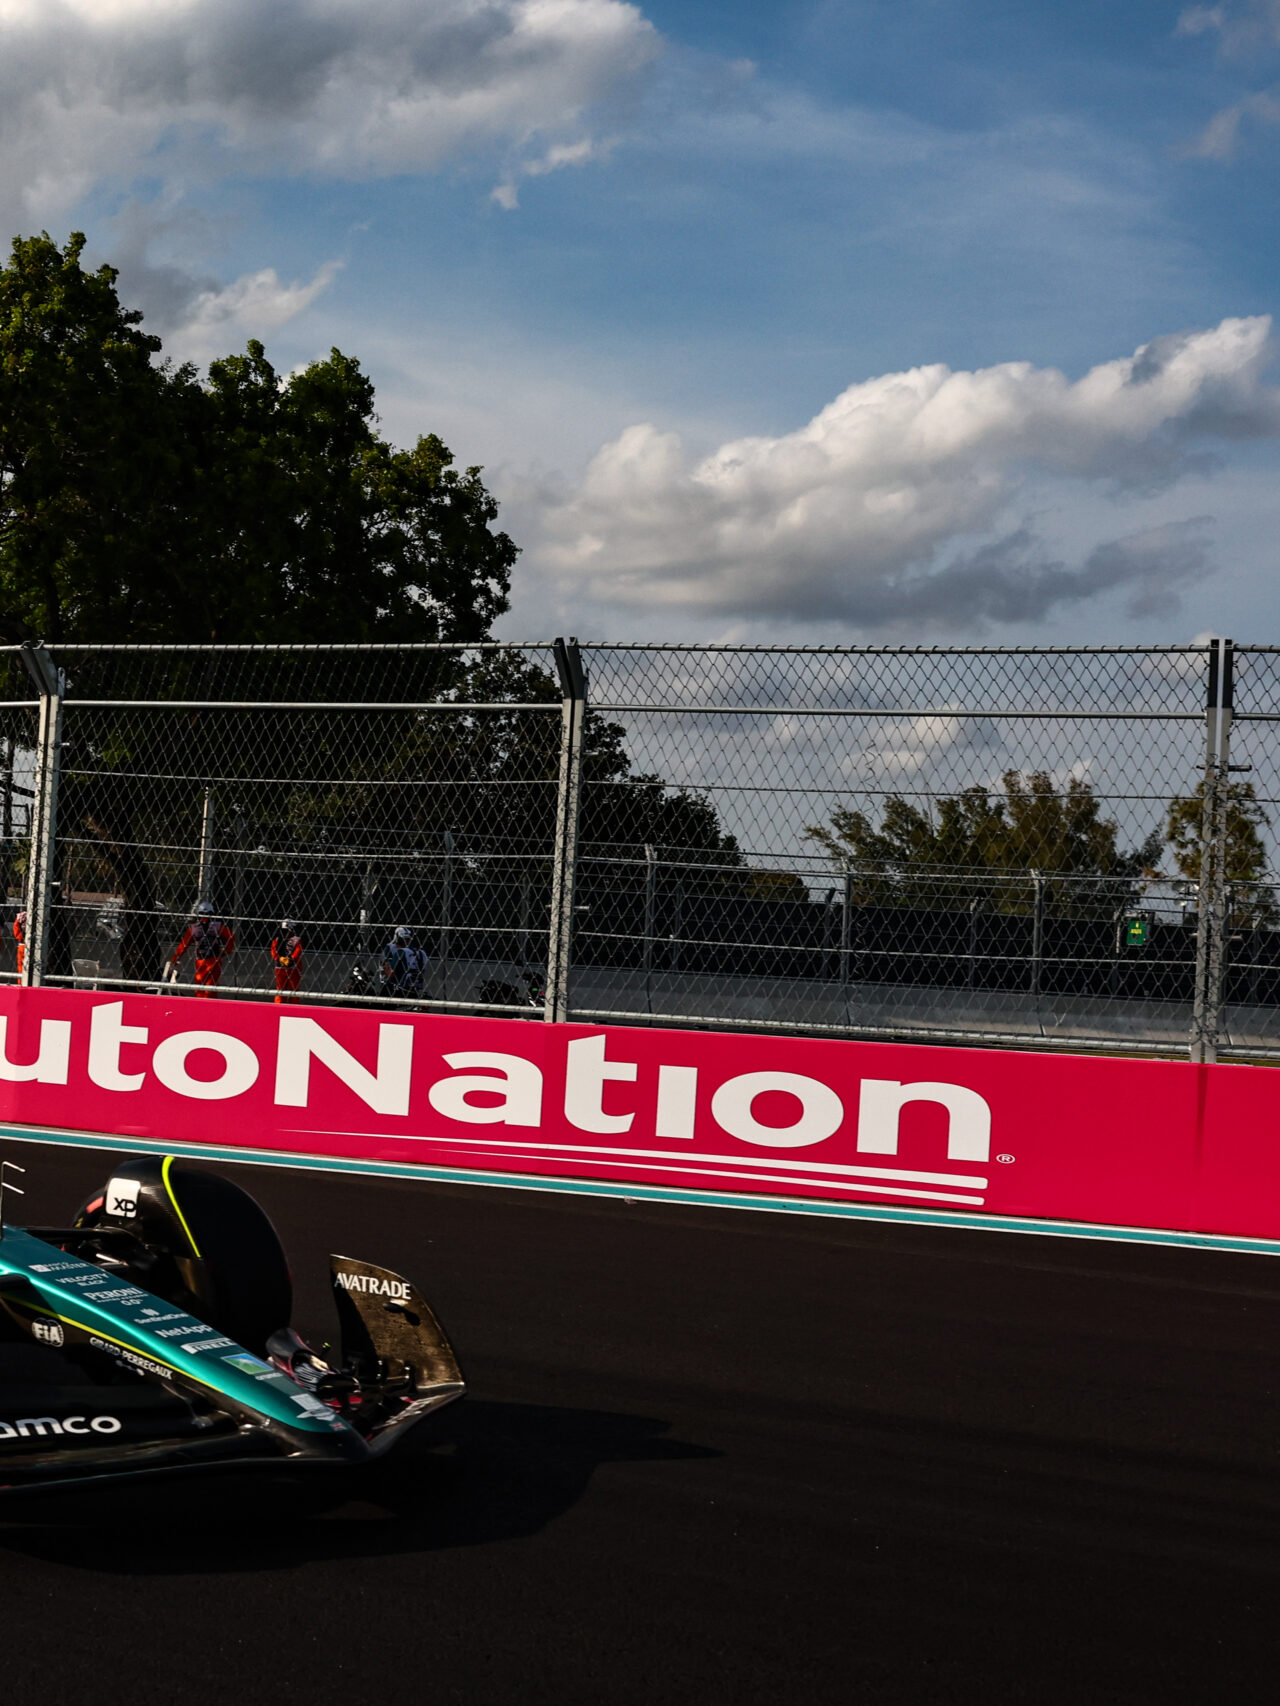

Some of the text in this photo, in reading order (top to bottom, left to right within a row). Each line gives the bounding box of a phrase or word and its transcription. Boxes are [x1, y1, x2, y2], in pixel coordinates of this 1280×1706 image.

[333, 1272, 412, 1300] AVATRADE
[82, 1287, 143, 1301] PERONI
[154, 1324, 214, 1338] NetApp
